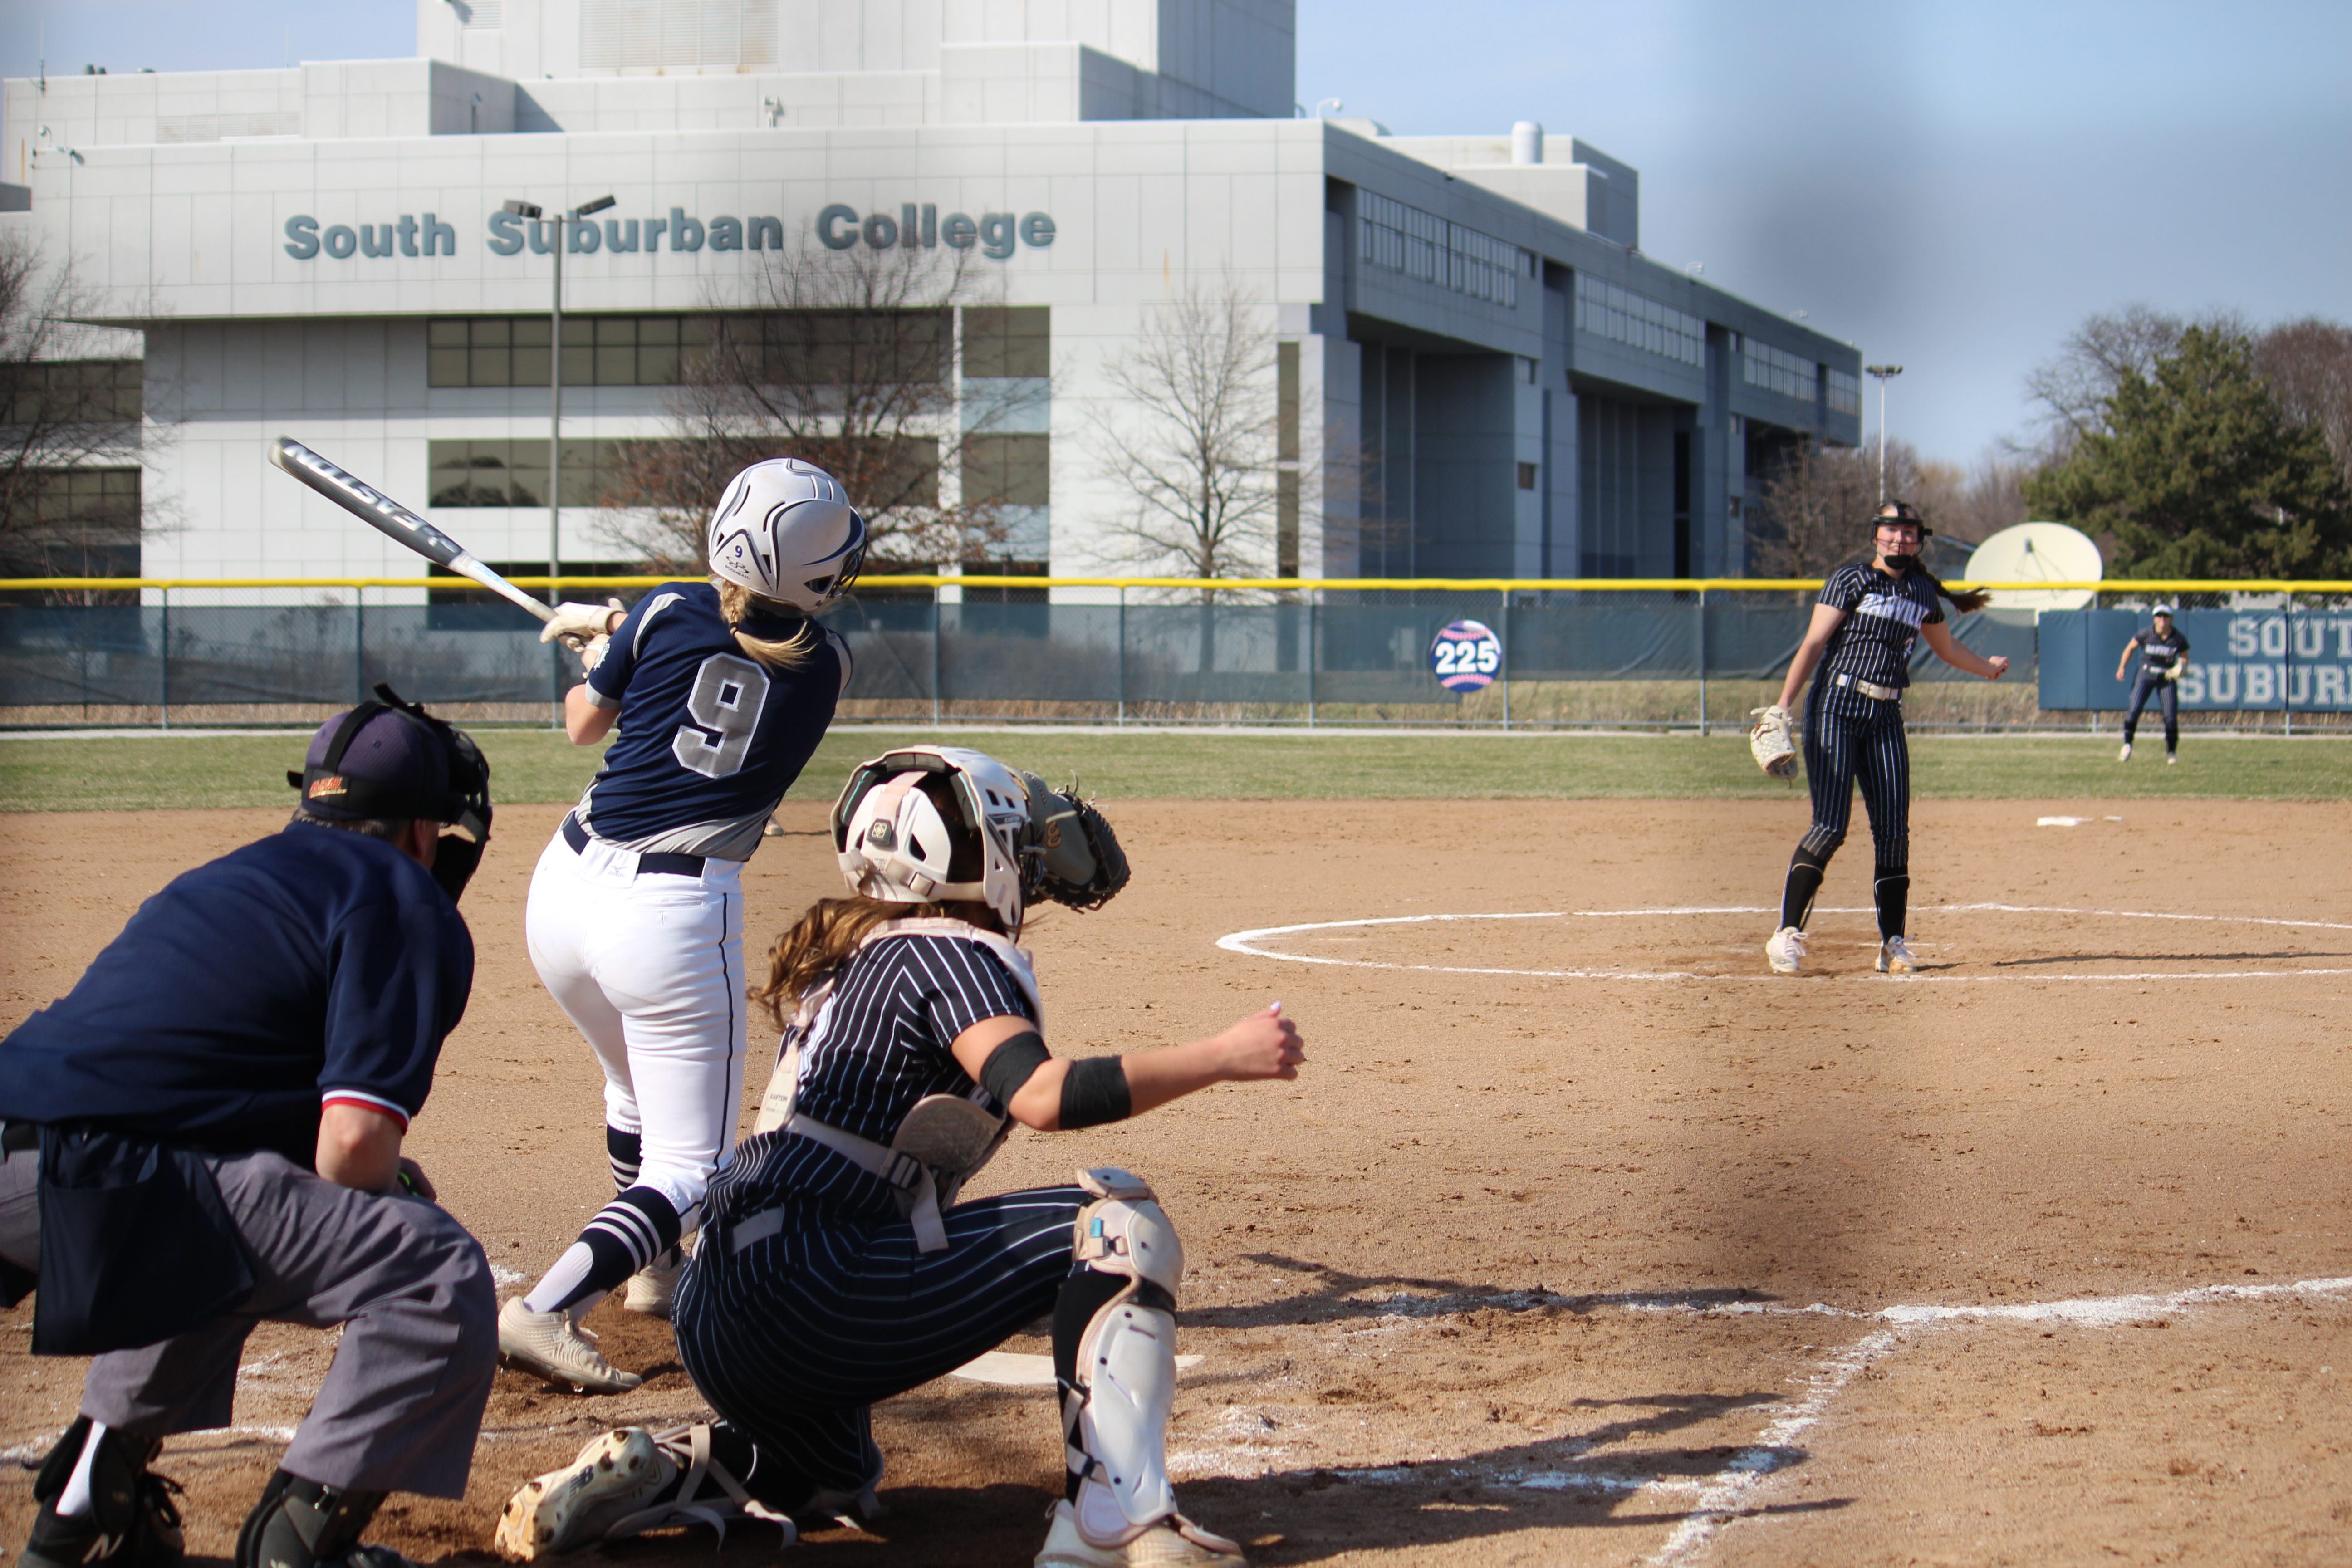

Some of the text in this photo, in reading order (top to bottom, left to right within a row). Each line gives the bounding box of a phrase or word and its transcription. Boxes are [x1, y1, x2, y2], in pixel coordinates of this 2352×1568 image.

[283, 203, 1057, 260] South Suburban College
[282, 444, 430, 532] EASTON
[735, 545, 743, 558] 9
[1435, 640, 1499, 674] 225
[2177, 663, 2352, 705] SUBUR
[672, 652, 770, 780] 9
